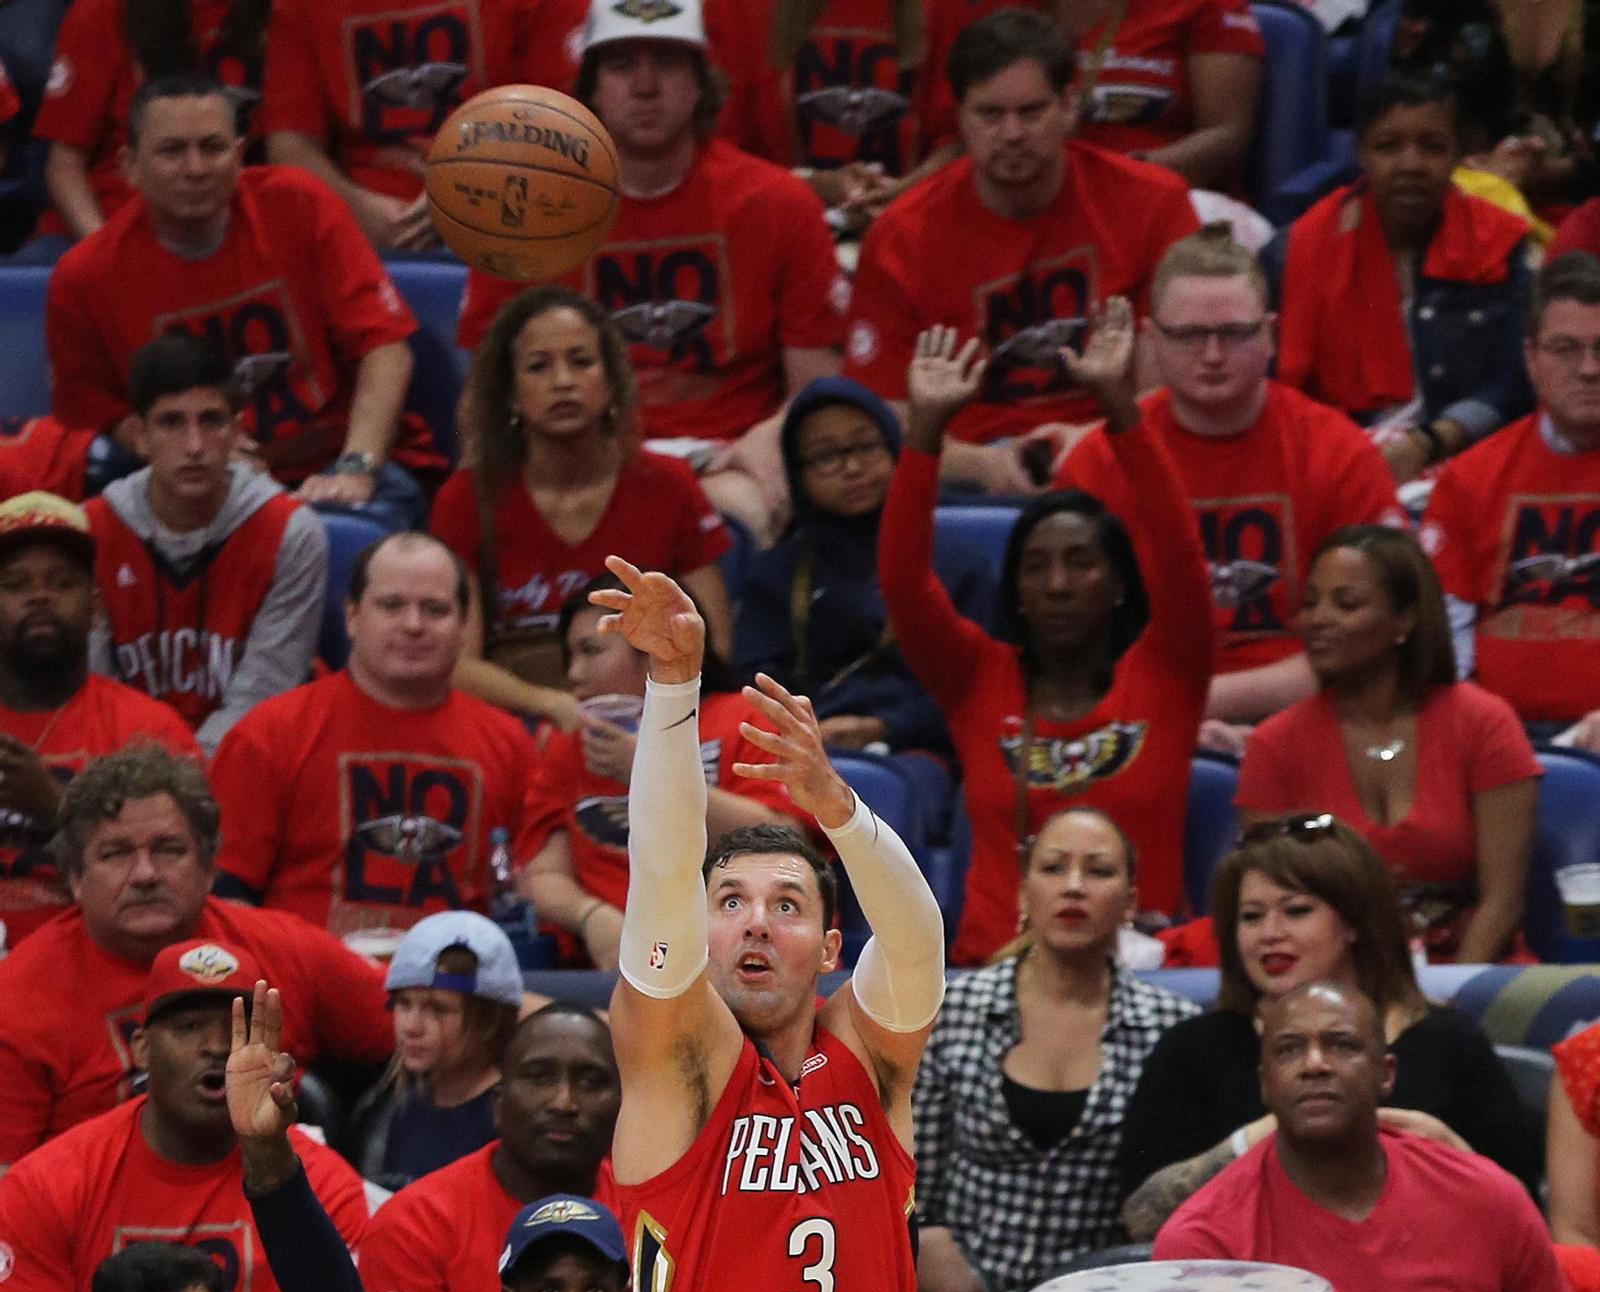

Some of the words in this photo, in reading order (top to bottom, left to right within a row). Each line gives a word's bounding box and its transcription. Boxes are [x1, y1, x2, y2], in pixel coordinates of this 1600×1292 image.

[456, 119, 590, 173] SPALDING
[597, 249, 718, 312] NO
[352, 762, 468, 832] NO
